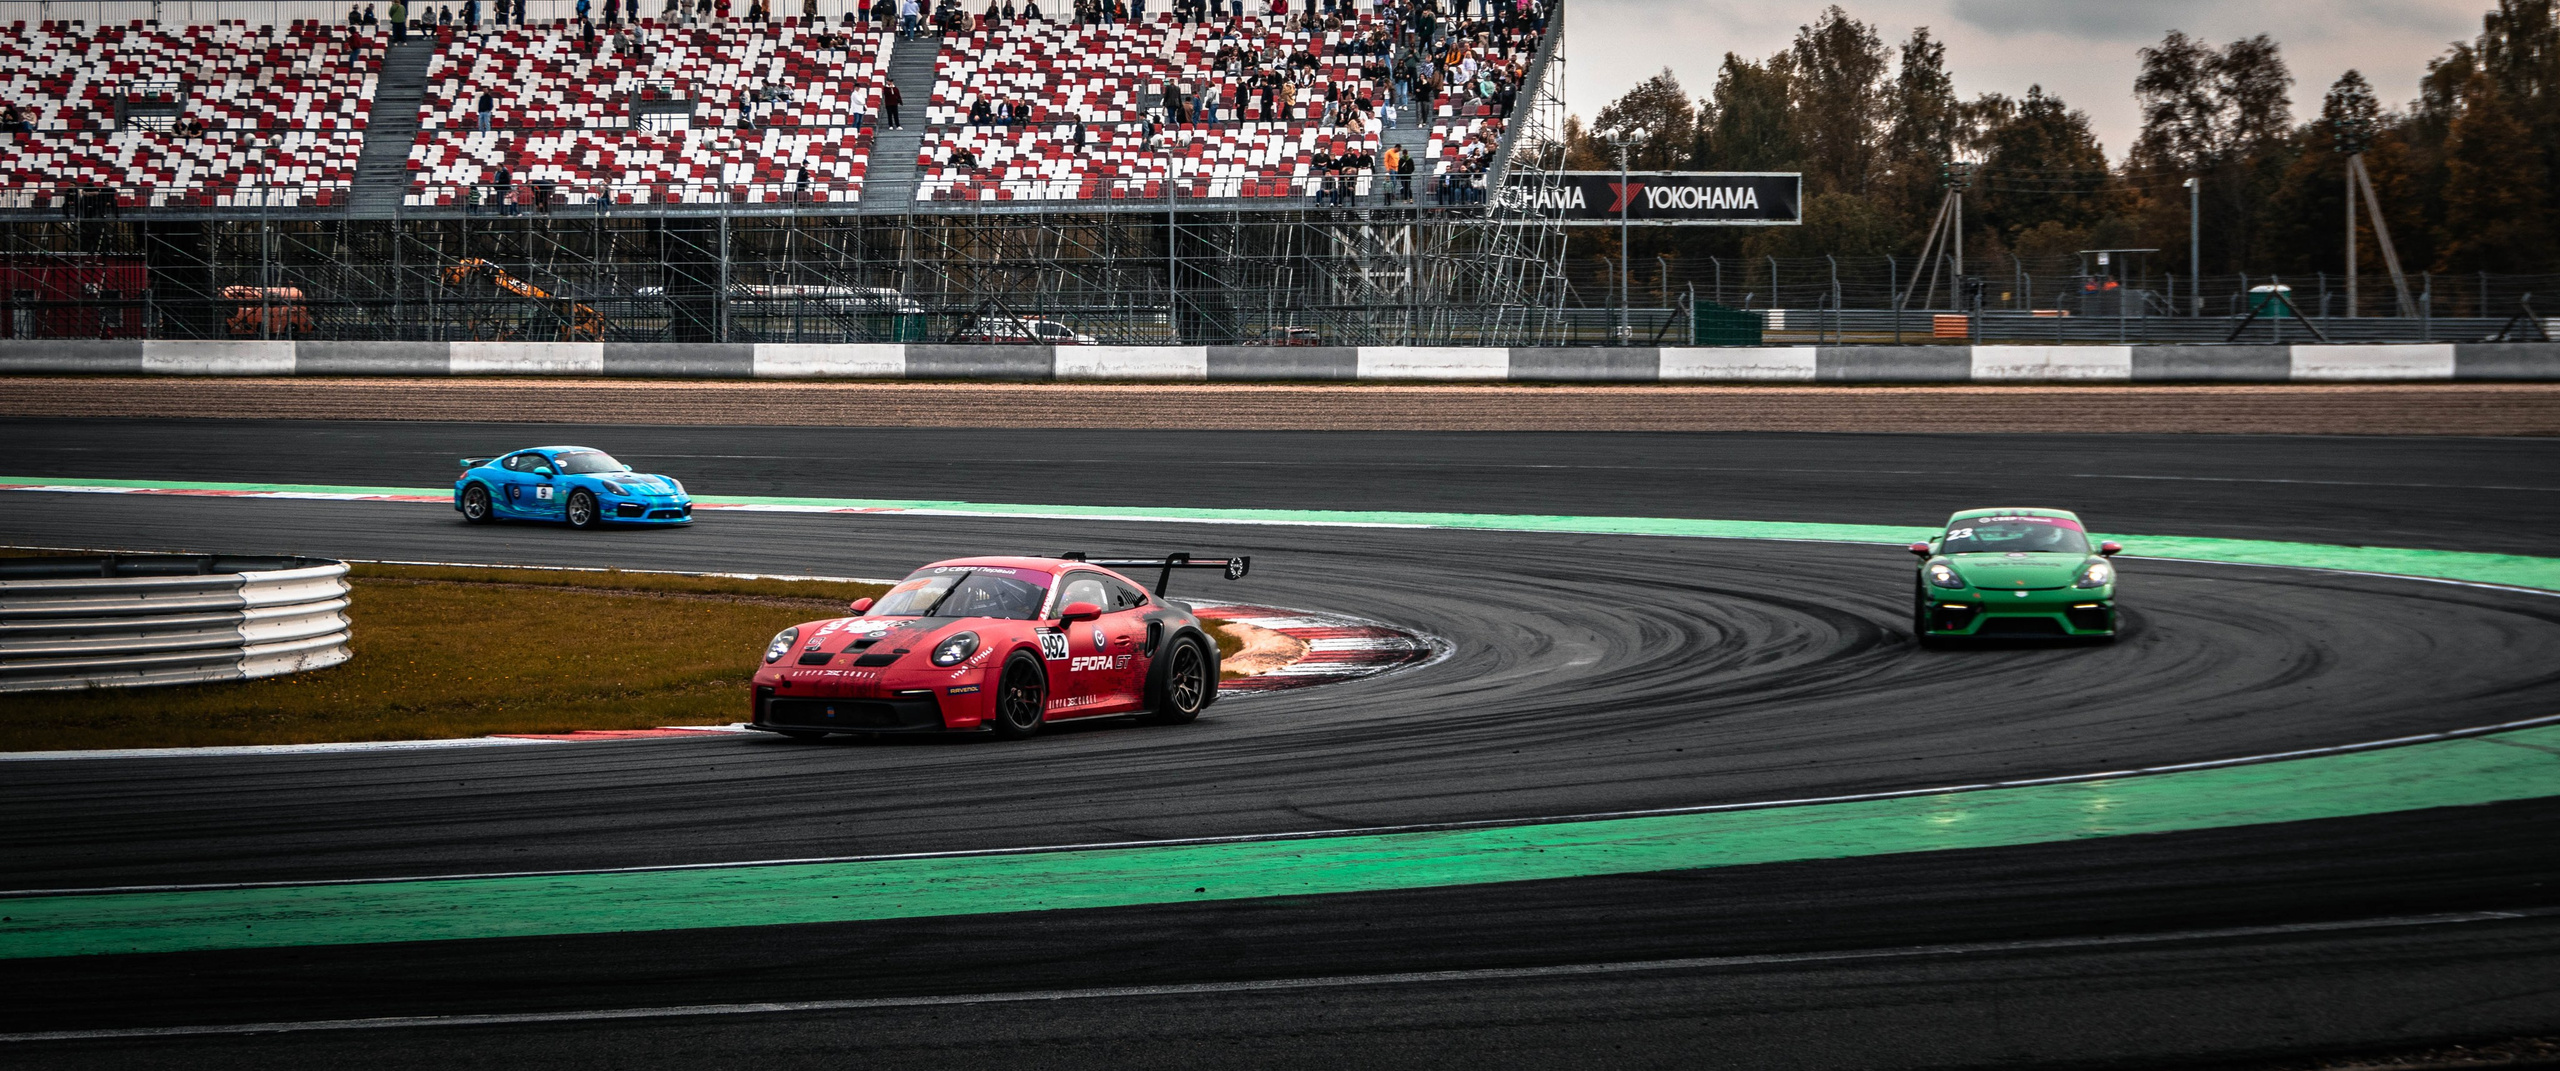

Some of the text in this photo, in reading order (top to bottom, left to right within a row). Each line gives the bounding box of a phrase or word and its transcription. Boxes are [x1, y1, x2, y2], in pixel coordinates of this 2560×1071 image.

[1643, 186, 1759, 209] YOKOHAMA
[510, 456, 518, 466] 9
[541, 488, 547, 498] 9
[1946, 527, 1974, 542] 23
[1041, 634, 1066, 659] 992
[1070, 654, 1132, 672] SPORA GT
